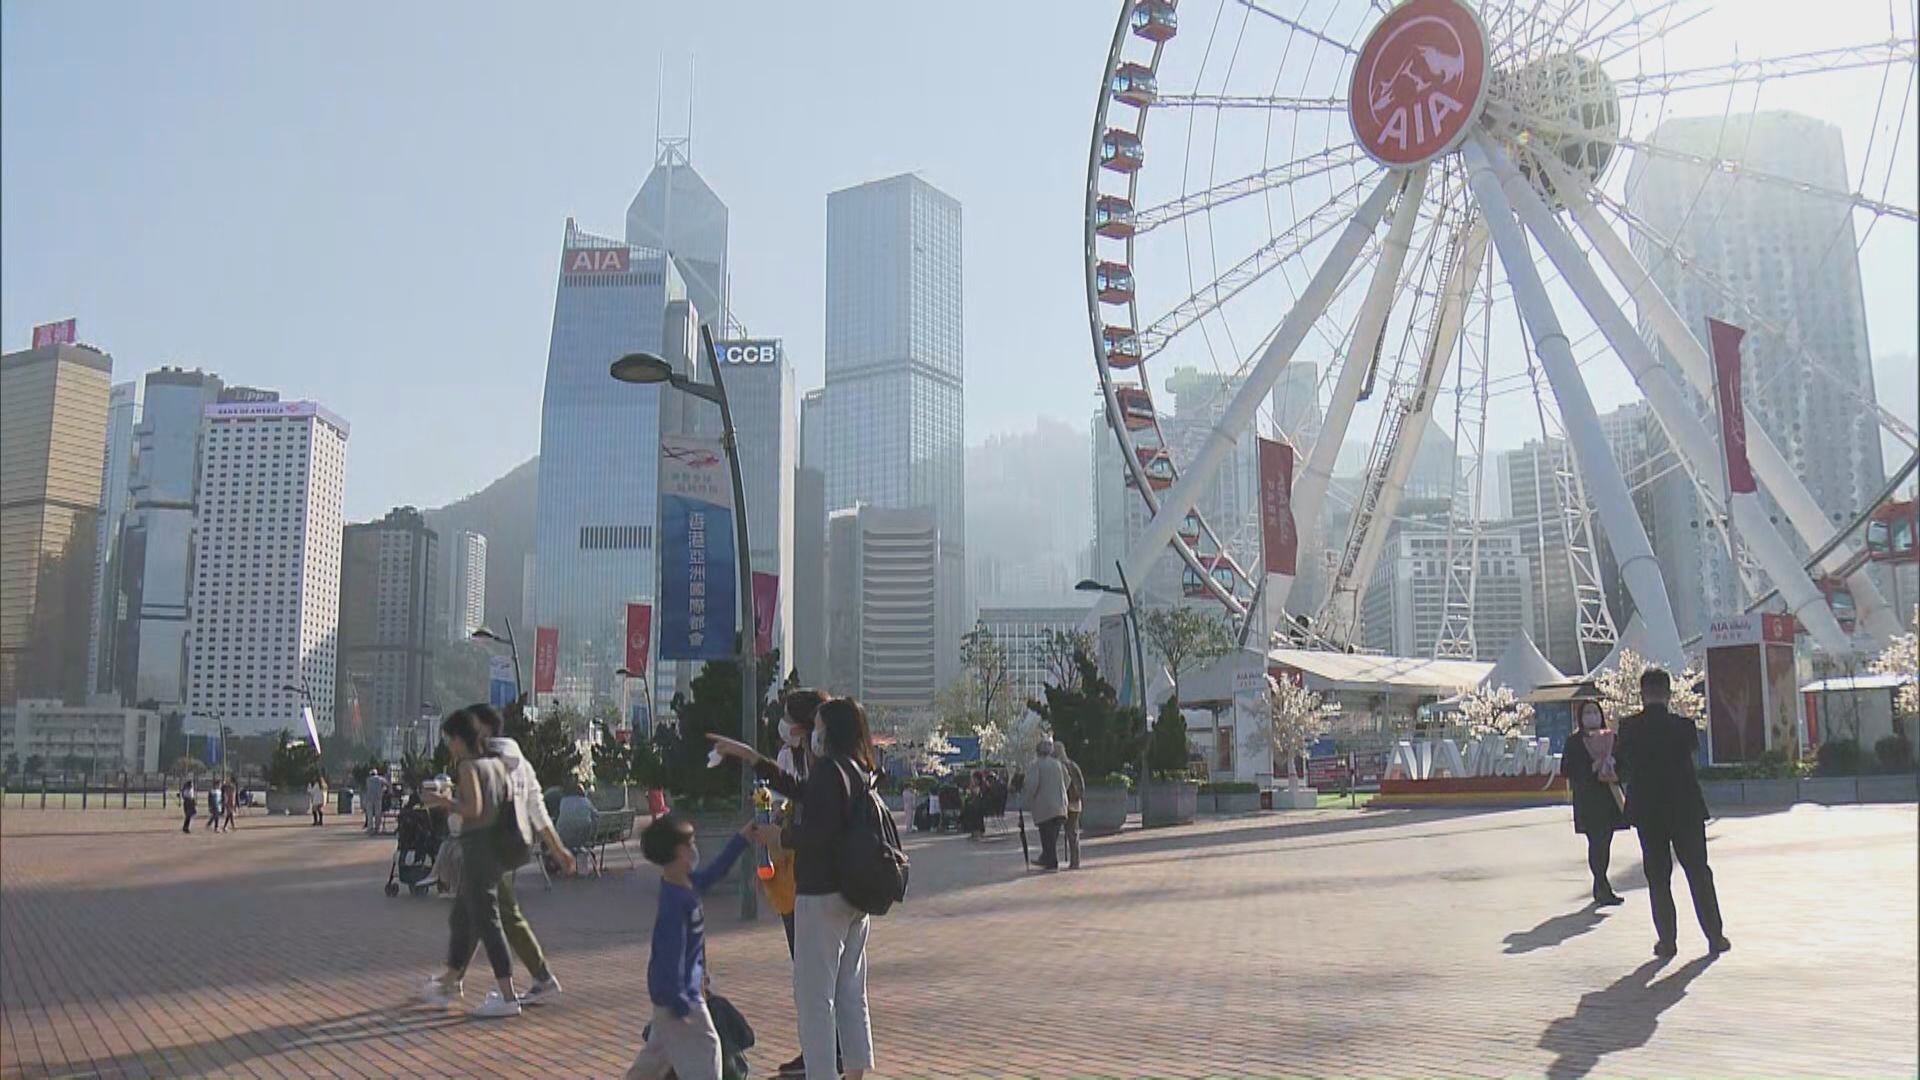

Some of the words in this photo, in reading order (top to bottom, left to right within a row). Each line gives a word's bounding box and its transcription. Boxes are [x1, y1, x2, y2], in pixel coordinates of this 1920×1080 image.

[1377, 91, 1463, 150] AIA
[572, 251, 622, 271] AIA
[726, 346, 775, 364] CCB
[235, 390, 274, 401] LIPPO
[250, 407, 284, 415] AMERICA
[688, 512, 705, 647] 香港亞洲國際都會
[1384, 738, 1467, 780] AIA
